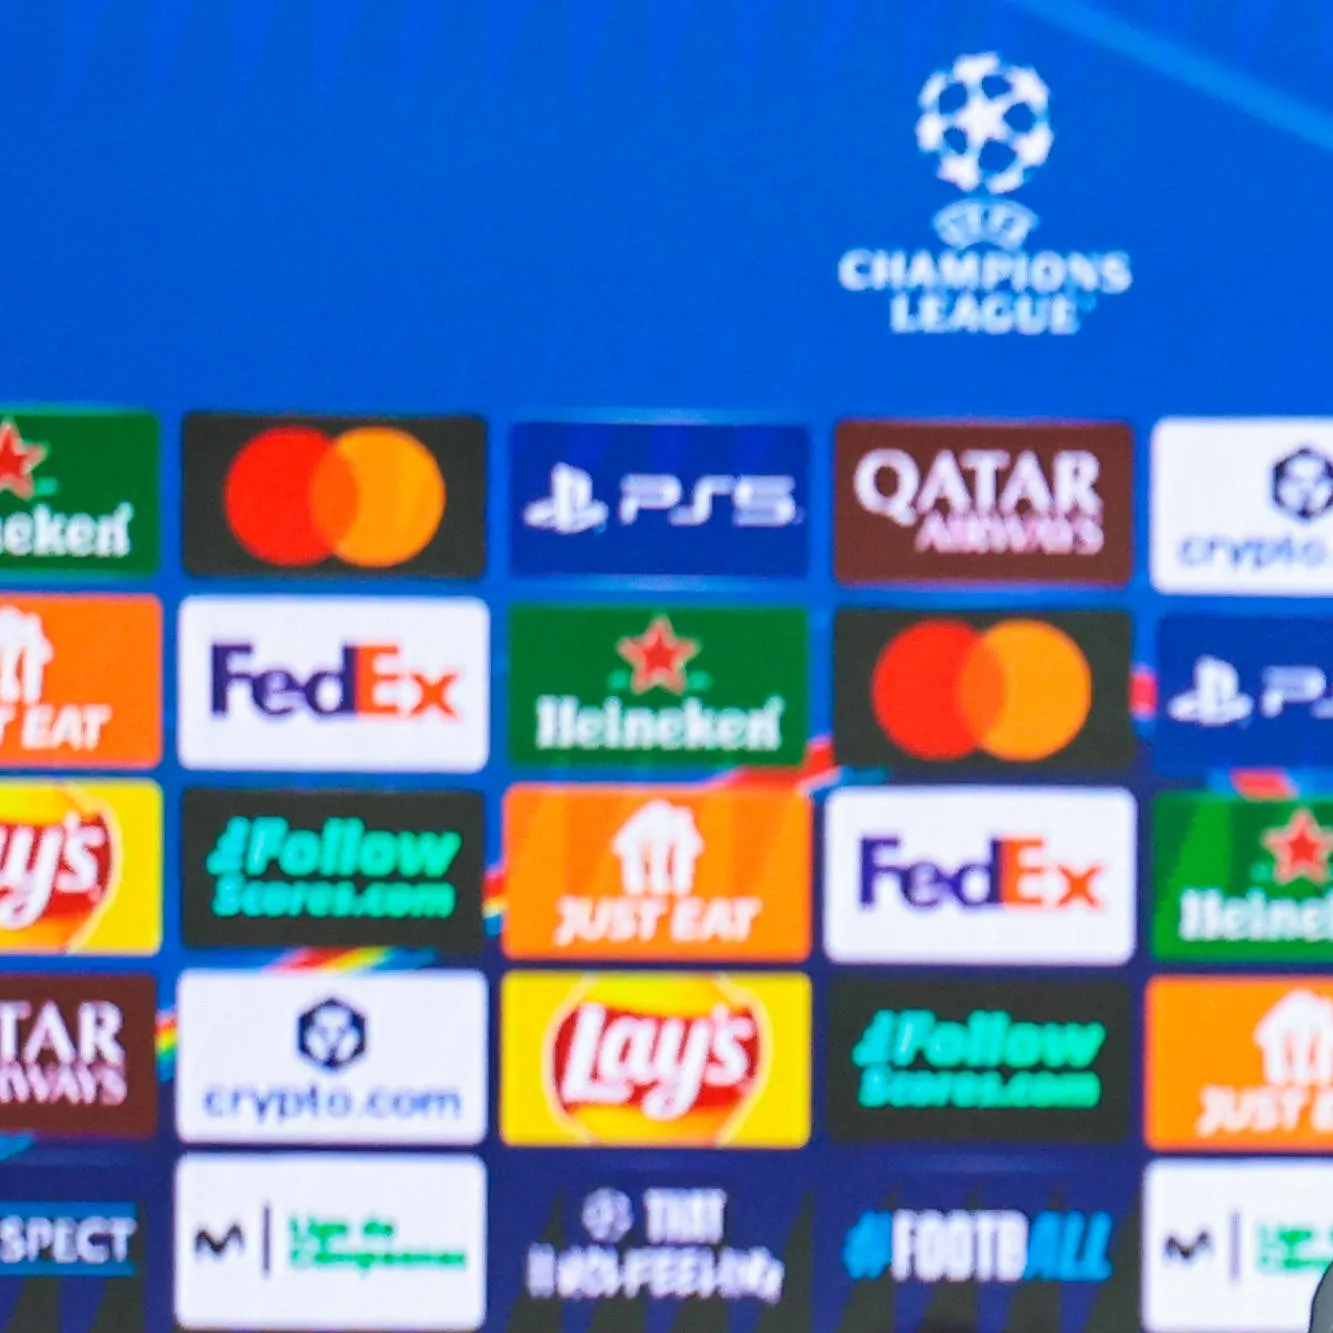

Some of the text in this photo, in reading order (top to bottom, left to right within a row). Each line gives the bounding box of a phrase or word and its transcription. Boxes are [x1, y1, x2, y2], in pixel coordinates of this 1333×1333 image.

[838, 248, 1132, 293] CHAMPIONS
[890, 292, 1080, 334] LEAGUE
[620, 474, 797, 527] PS5
[854, 449, 1100, 525] QATAR
[0, 501, 134, 558] eken
[211, 642, 460, 721] FedEx
[21, 702, 113, 752] EAT
[535, 694, 785, 751] Heineken
[860, 835, 1109, 912] FedEx
[555, 896, 764, 946] JUST EAT
[561, 1002, 755, 1121] Lay's
[204, 1083, 463, 1122] crypto.com
[1197, 1088, 1308, 1136] JUST
[0, 1215, 138, 1264] SPECT
